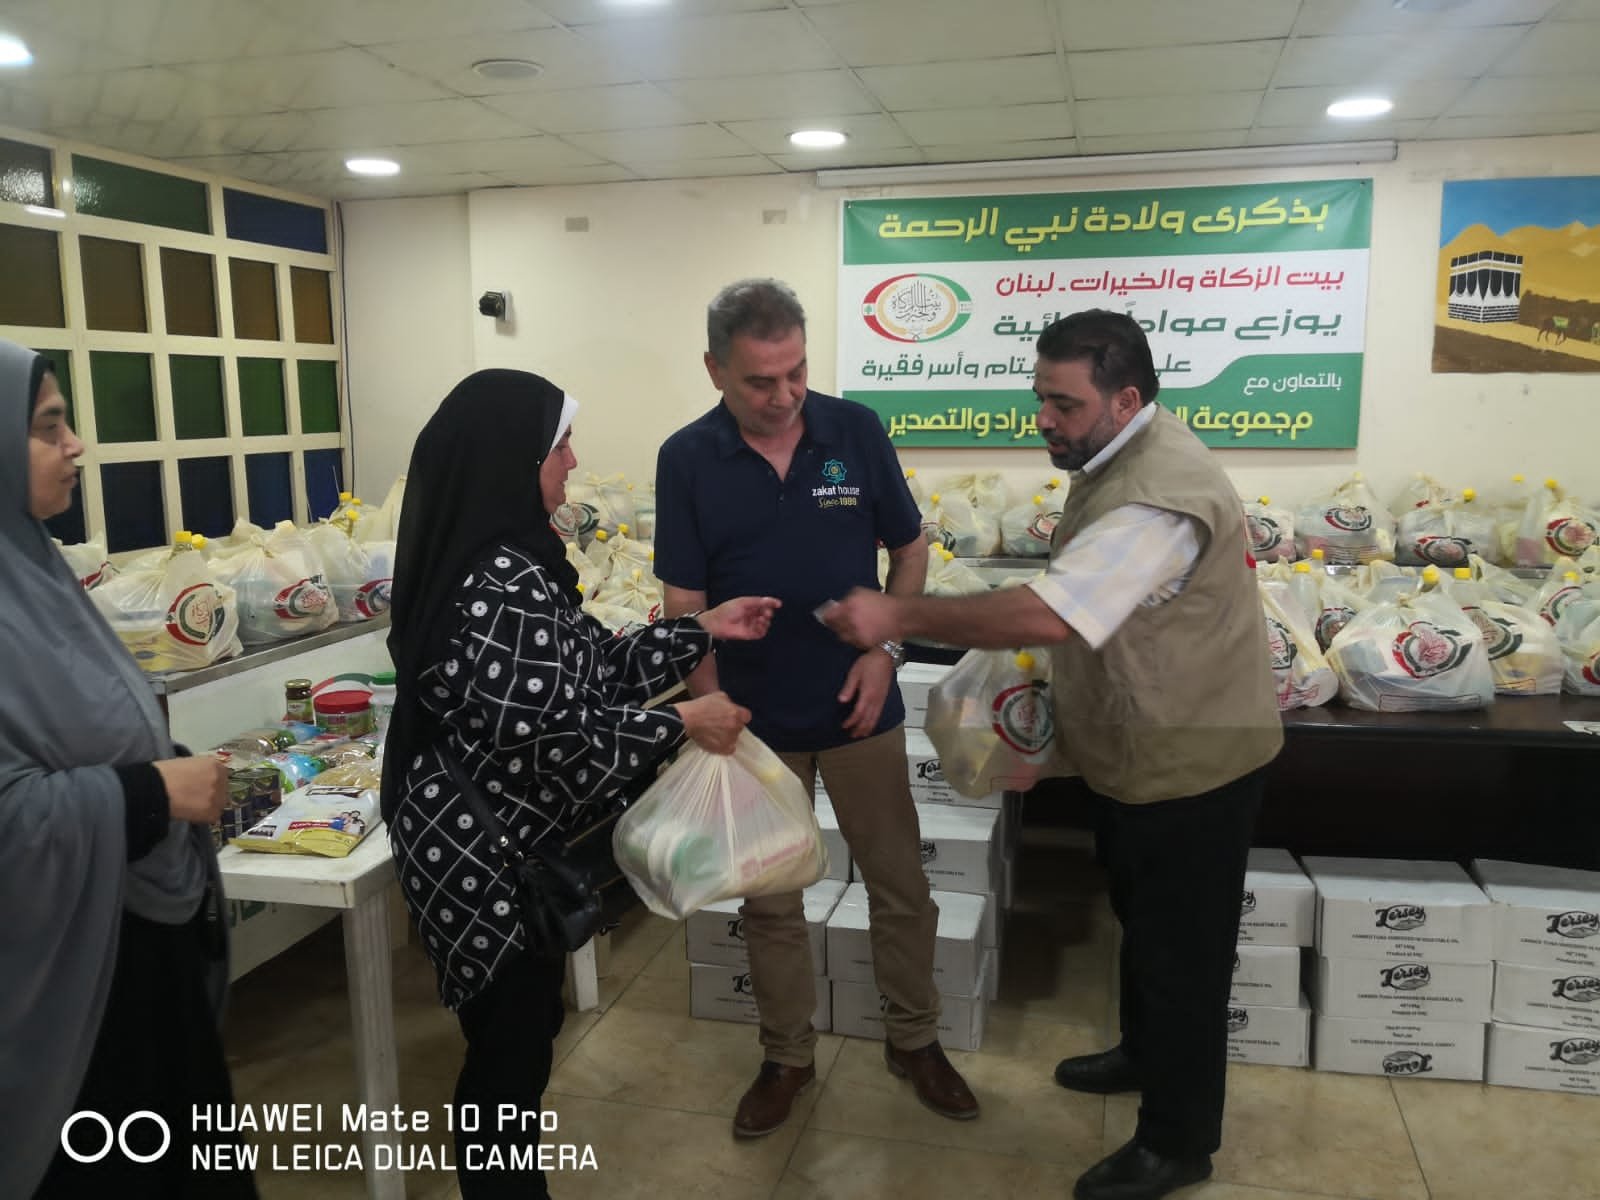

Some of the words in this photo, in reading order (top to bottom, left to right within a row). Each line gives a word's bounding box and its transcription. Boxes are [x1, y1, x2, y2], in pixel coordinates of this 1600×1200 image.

[878, 207, 999, 244] الرحمة
[1004, 206, 1079, 253] نبي
[1084, 201, 1186, 235] ولادة
[1192, 197, 1329, 235] بذكرى
[995, 271, 1055, 297] لبنان
[1070, 268, 1195, 297] والخيرات
[1199, 265, 1281, 292] الزكاة
[1286, 270, 1345, 291] بيت
[1234, 307, 1342, 341] يوزع
[862, 353, 924, 381] فقيرة
[927, 351, 980, 380] وأسر
[1243, 376, 1270, 396] مع
[1272, 372, 1343, 394] بالتعاون
[887, 407, 991, 438] والتصدير
[1193, 405, 1314, 440] مجموعة
[811, 484, 837, 497] zakat
[837, 484, 860, 496] house
